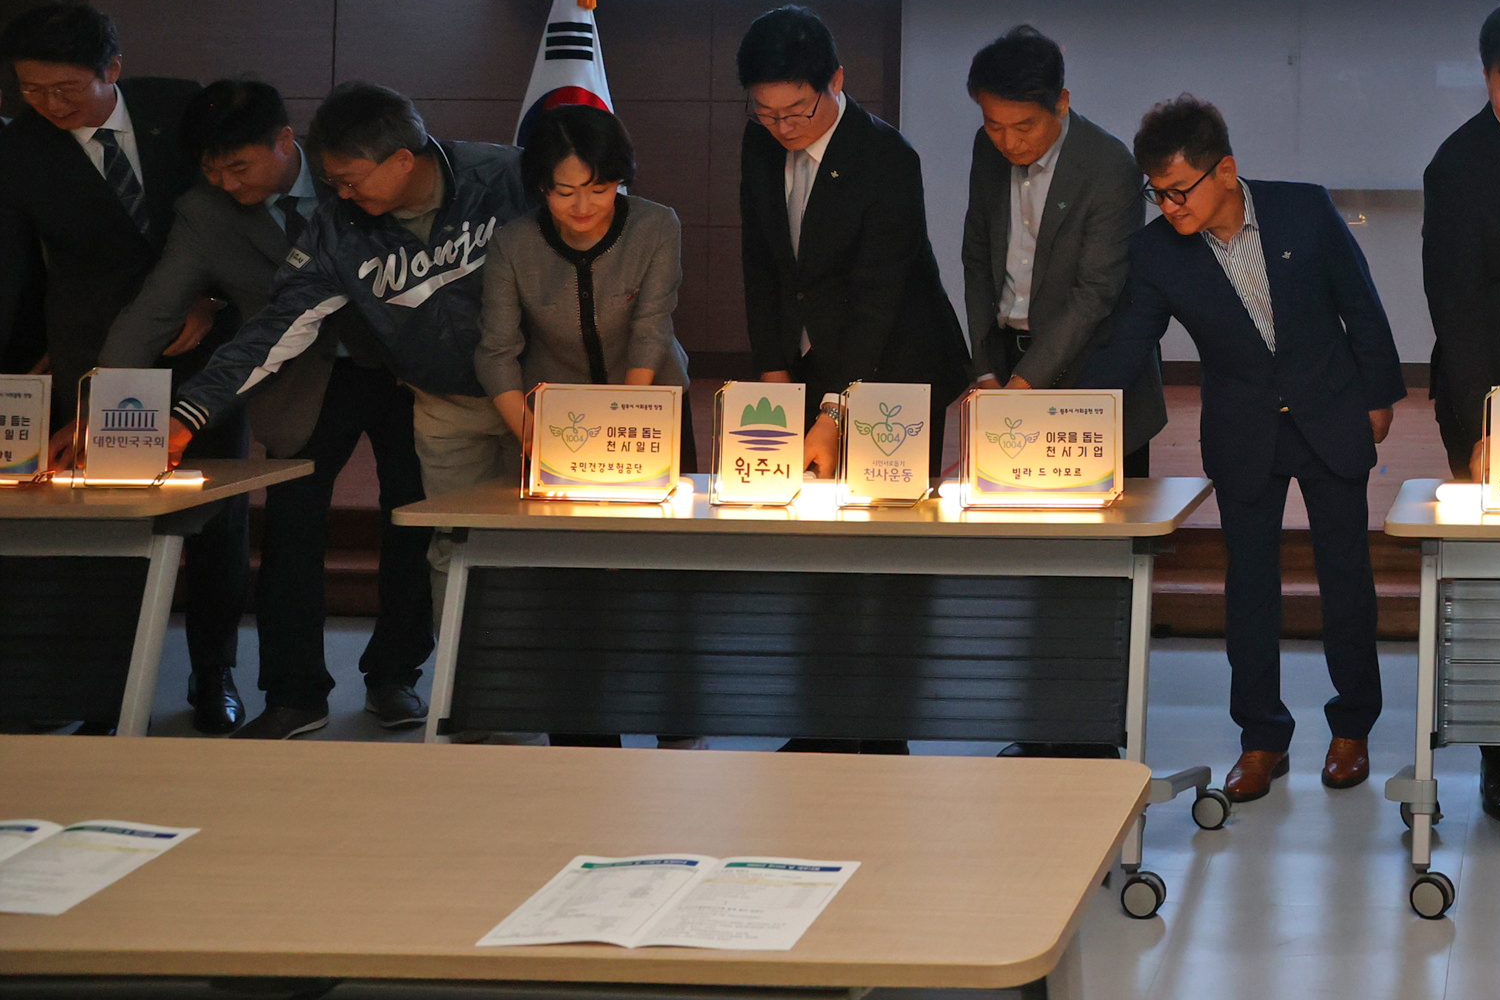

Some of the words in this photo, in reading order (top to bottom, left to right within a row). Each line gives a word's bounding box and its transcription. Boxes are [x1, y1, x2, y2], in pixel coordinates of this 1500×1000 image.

[358, 216, 496, 298] Wonju
[566, 434, 584, 443] 1004
[607, 426, 637, 439] 이웃을
[642, 426, 662, 439] 돕는
[876, 432, 901, 443] 1004
[1046, 431, 1077, 444] 이웃을
[1082, 431, 1103, 444] 돕는
[1003, 440, 1022, 449] 1004
[570, 461, 643, 475] 국민건강보험공단
[735, 456, 790, 483] 원주시
[1012, 468, 1032, 480] 빌라
[1053, 468, 1082, 477] 아모르
[863, 467, 914, 483] 천사운동
